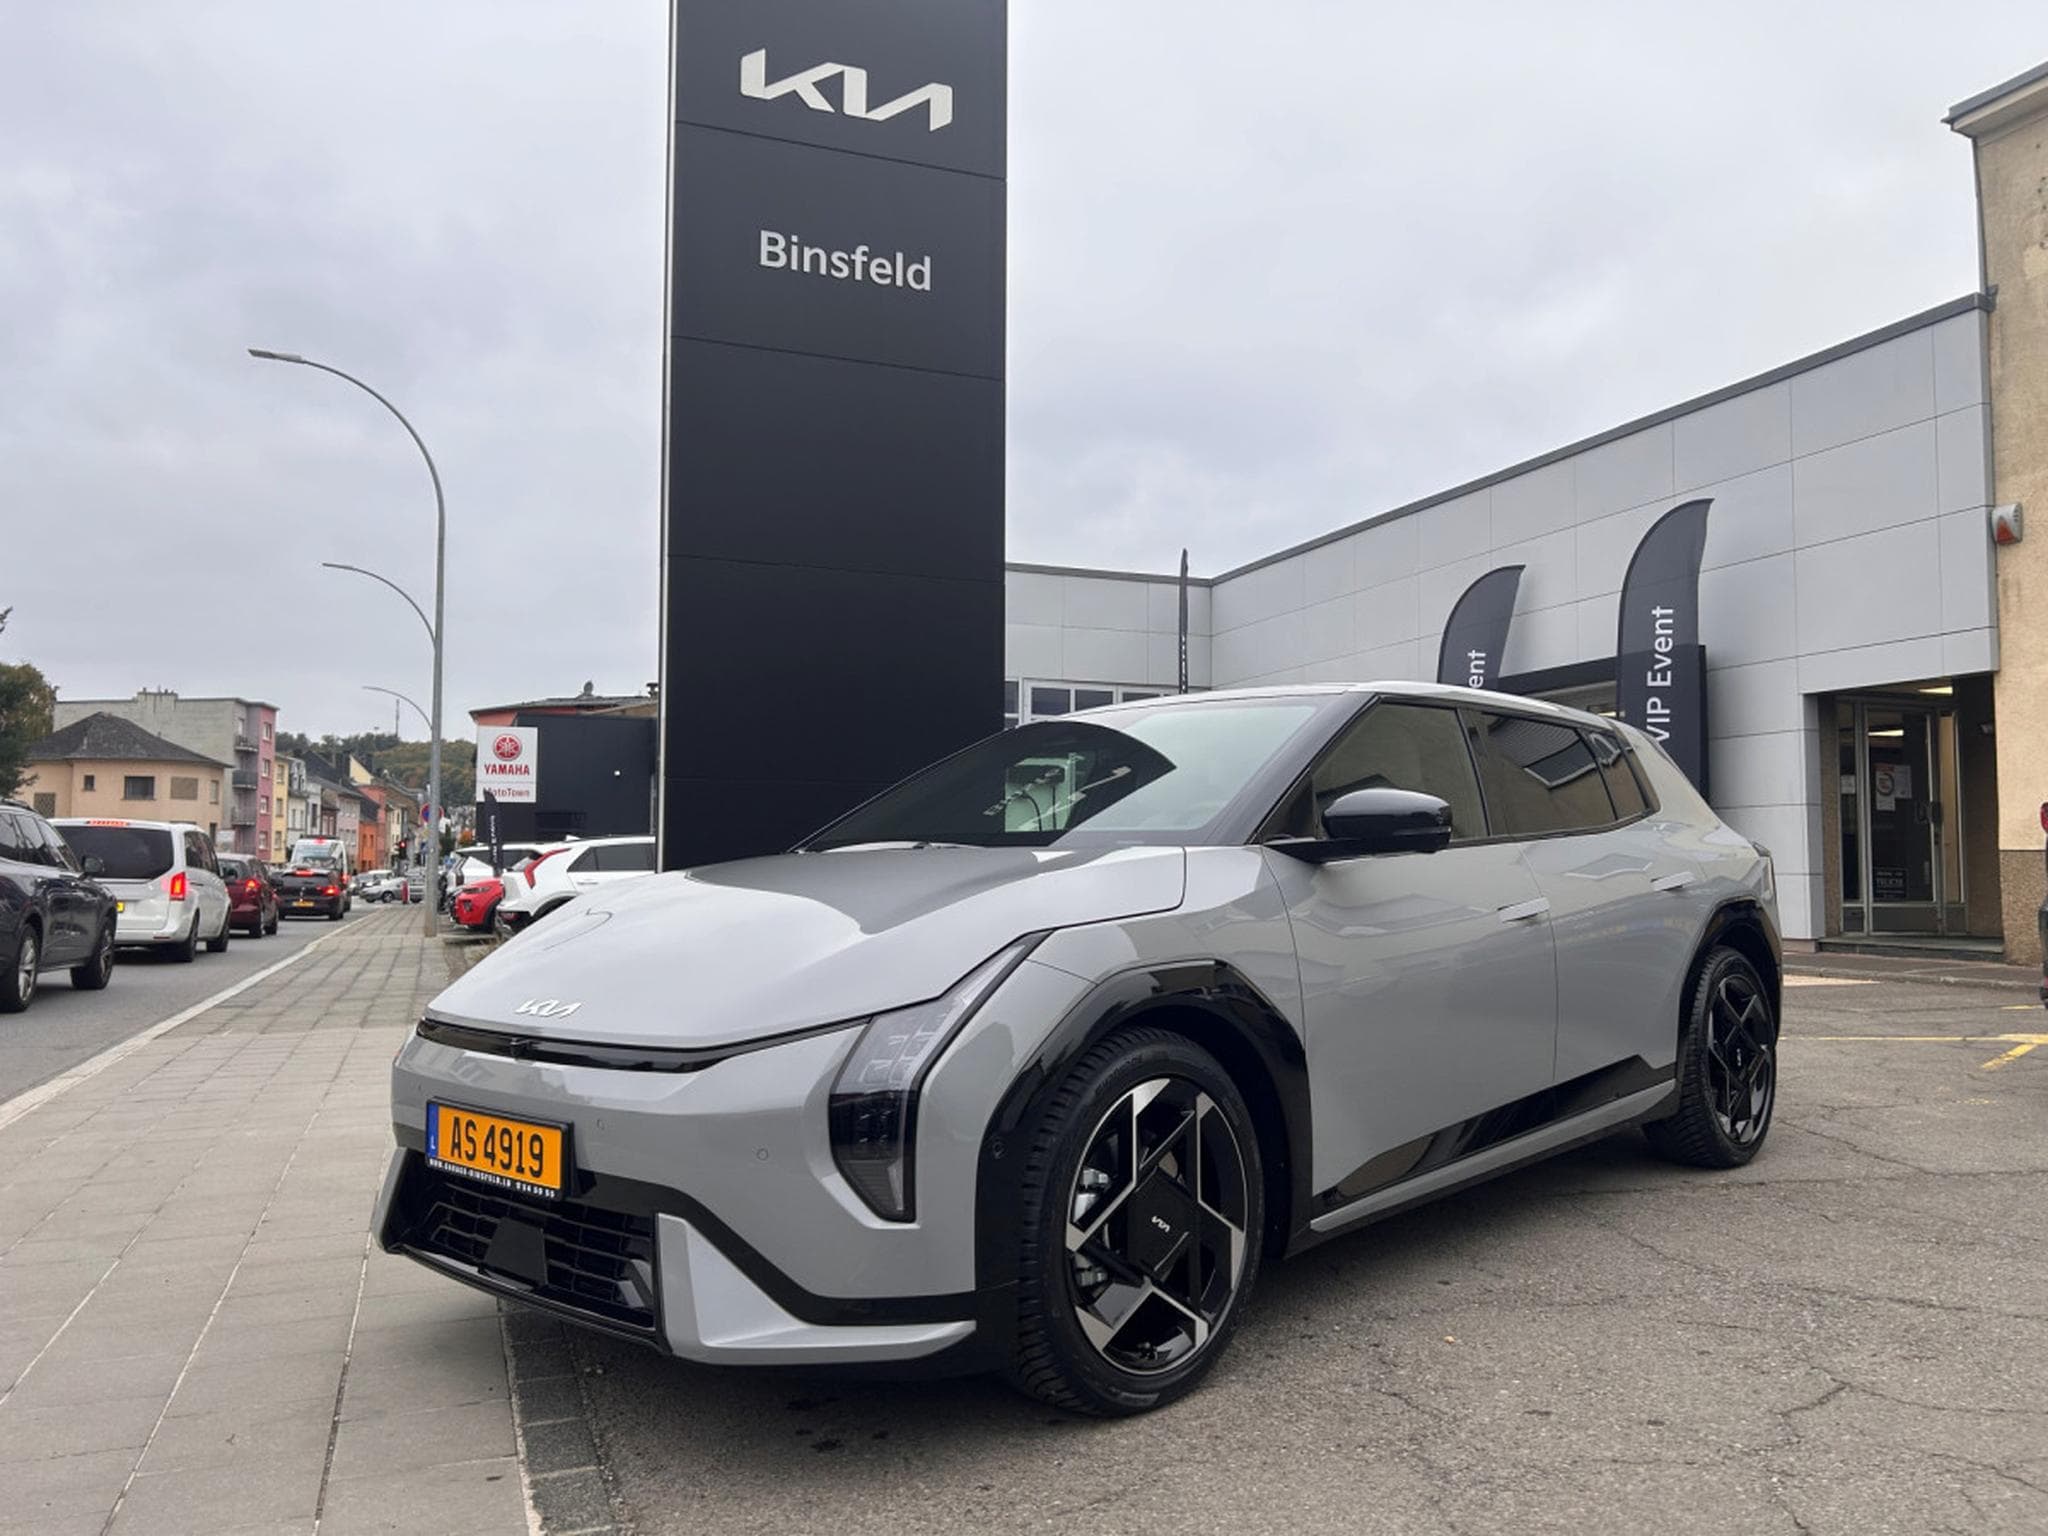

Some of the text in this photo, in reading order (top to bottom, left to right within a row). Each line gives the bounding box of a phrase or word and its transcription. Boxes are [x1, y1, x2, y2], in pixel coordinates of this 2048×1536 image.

[760, 229, 932, 291] Binsfeld
[1646, 606, 1675, 742] VIP Event
[484, 764, 530, 775] YAMAHA
[450, 1116, 544, 1178] AS 4919
